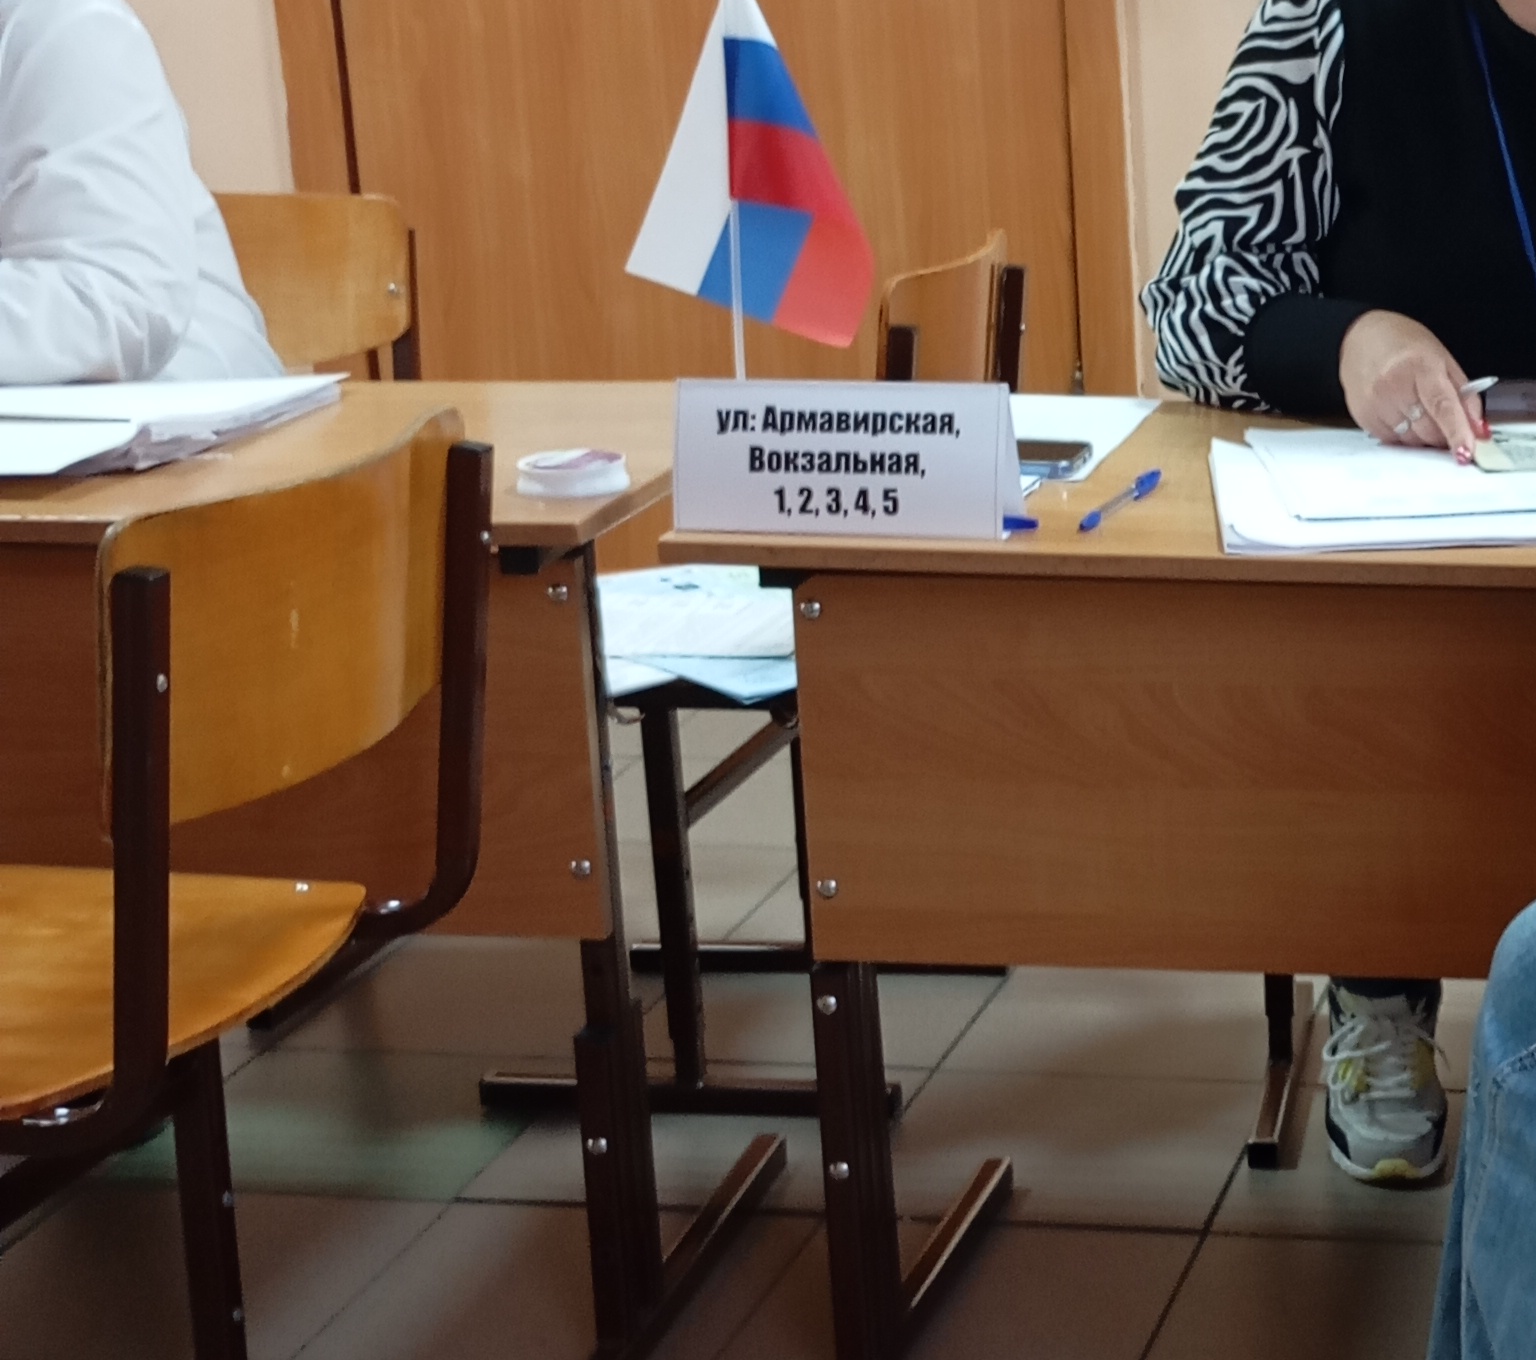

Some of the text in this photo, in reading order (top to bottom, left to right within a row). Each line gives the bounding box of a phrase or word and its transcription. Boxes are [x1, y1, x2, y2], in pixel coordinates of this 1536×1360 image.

[717, 405, 961, 438] ул: Армавирская,
[749, 445, 925, 478] Вокзальная,
[774, 486, 899, 518] 1, 2, 3, 4, 5
